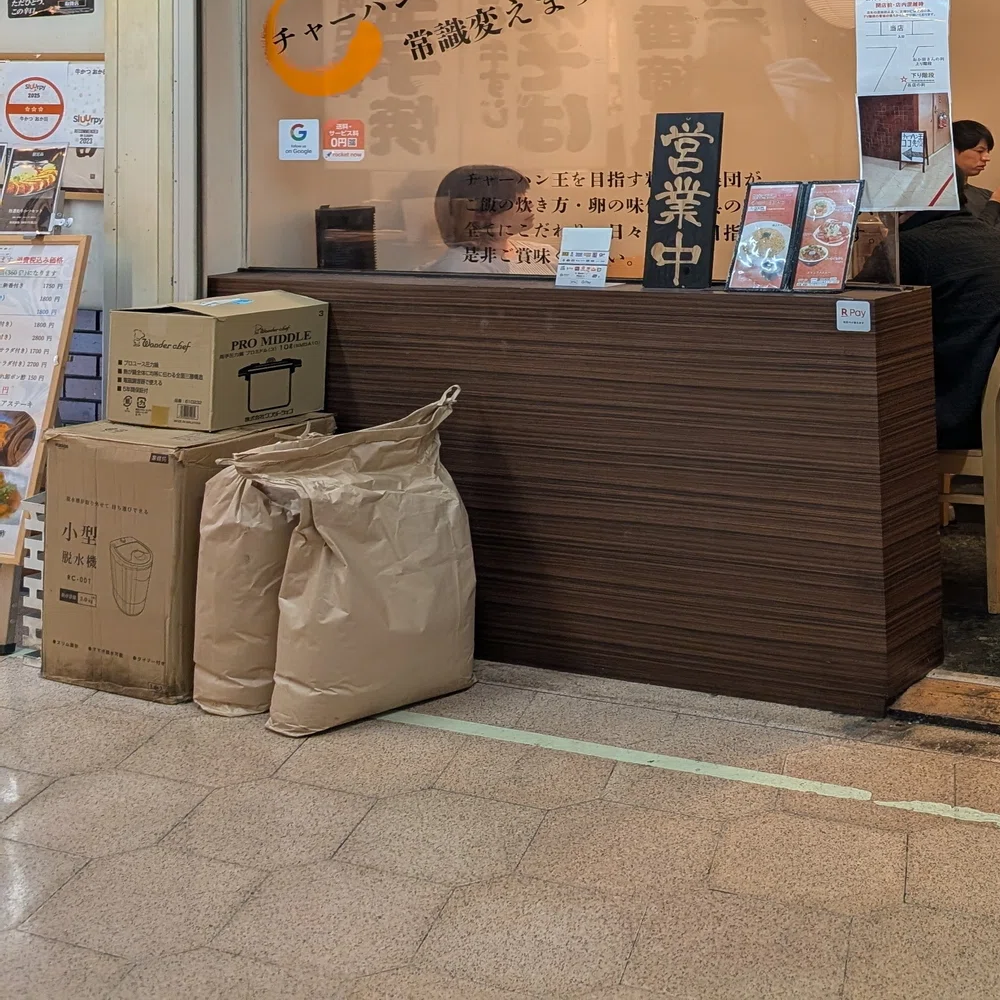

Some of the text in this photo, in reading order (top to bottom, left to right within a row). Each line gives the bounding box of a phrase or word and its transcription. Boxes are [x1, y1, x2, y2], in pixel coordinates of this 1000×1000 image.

[465, 171, 761, 188] チャーハン王を目指す団が
[651, 121, 714, 287] 営業中
[841, 309, 866, 318] R Pay
[231, 331, 312, 351] PRO MIDDLE
[62, 521, 97, 546] 小型
[62, 551, 97, 569] 脱水機
